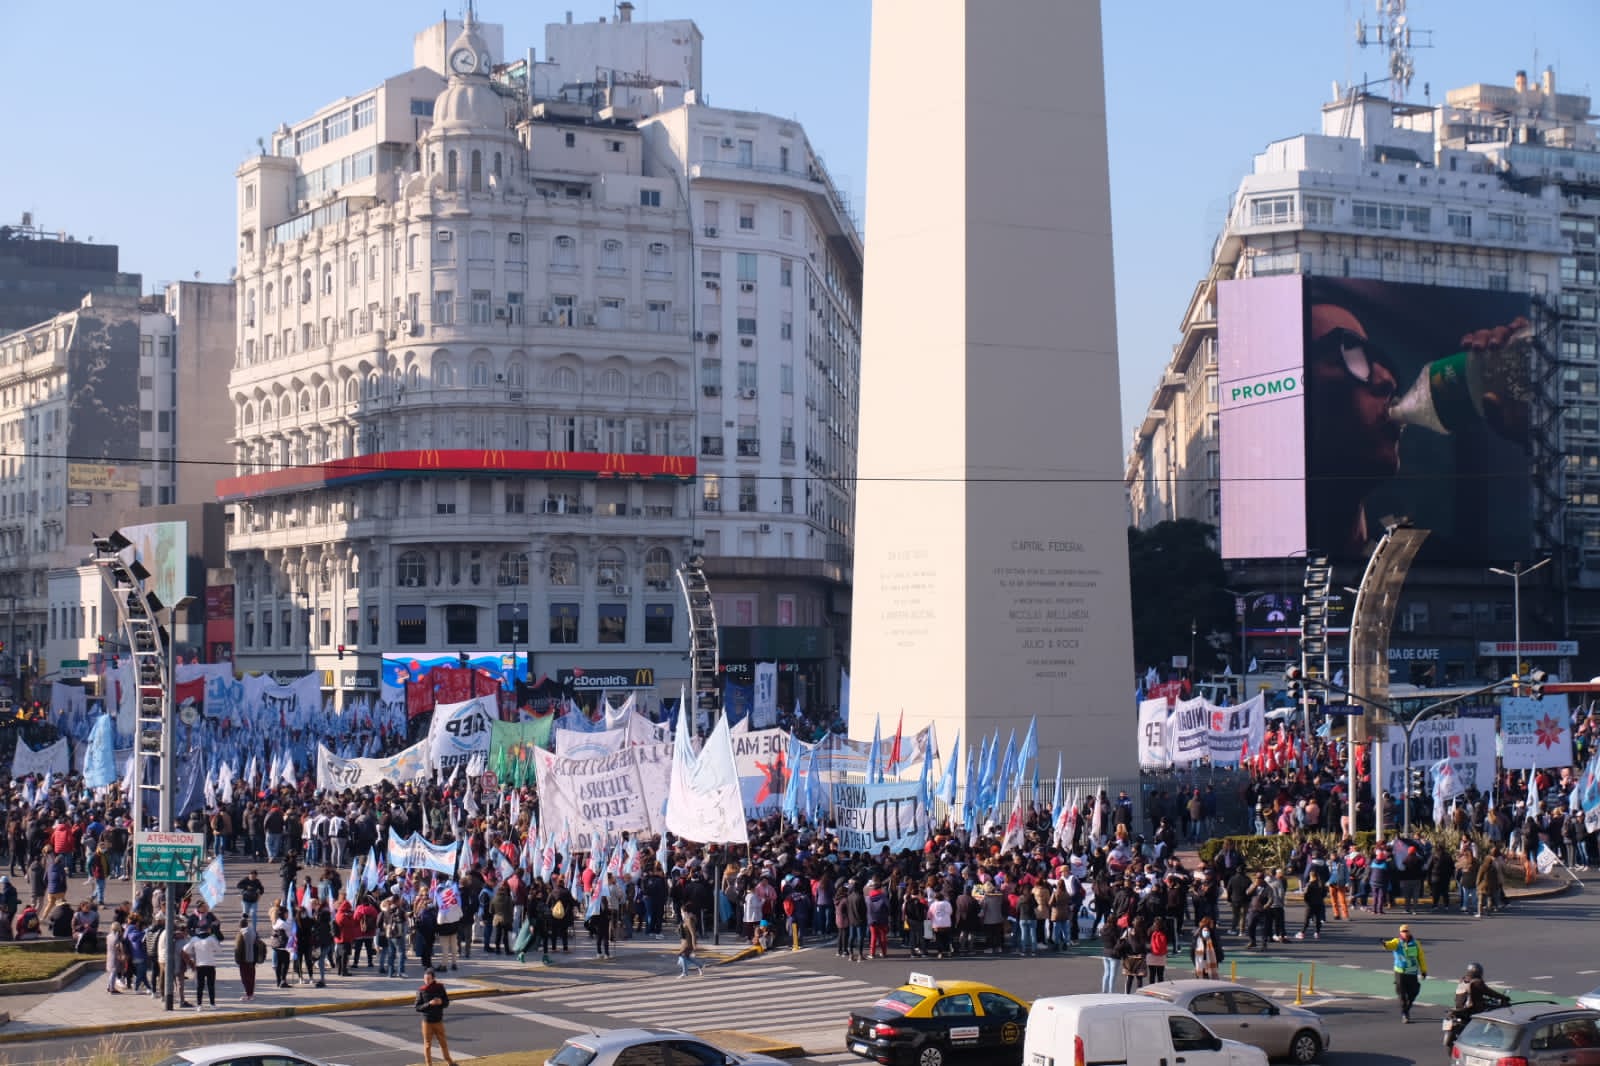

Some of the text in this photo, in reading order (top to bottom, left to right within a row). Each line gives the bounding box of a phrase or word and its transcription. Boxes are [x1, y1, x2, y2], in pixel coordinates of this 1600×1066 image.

[1231, 376, 1297, 401] PROMO
[726, 664, 748, 673] GIFTS
[563, 675, 628, 686] McDonald's
[146, 834, 194, 843] ATENCION
